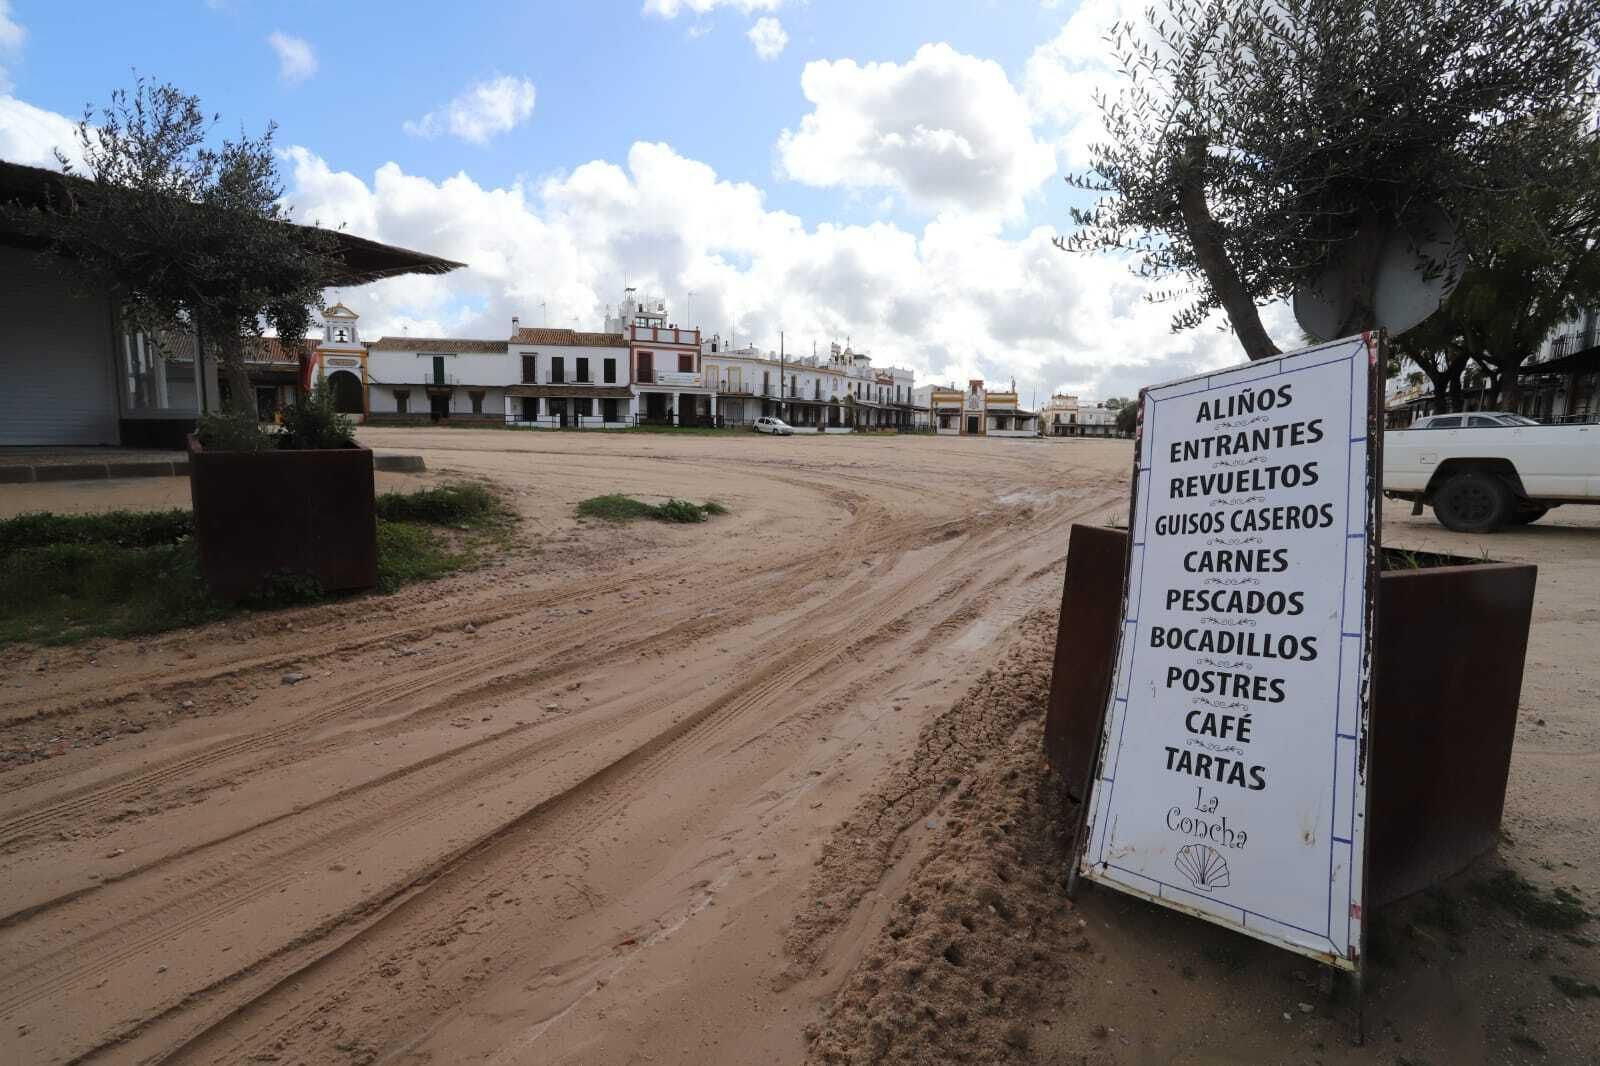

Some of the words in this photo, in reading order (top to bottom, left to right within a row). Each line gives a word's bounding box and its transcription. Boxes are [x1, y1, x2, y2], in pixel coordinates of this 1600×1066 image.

[1196, 384, 1293, 423] ALIÑOS
[1170, 419, 1324, 463] ENTRANTES
[1170, 461, 1319, 499] REVUELTOS
[1155, 511, 1225, 536] GUISOS
[1230, 503, 1334, 533] CASEROS
[1183, 549, 1289, 573] CARNES
[1166, 589, 1305, 616] PESCADOS
[1150, 627, 1318, 661] BOCADILLOS
[1166, 666, 1286, 703] POSTRES
[1185, 710, 1252, 743] CAFÉ
[1165, 746, 1267, 791] TARTAS
[1194, 787, 1219, 815] La
[1166, 806, 1249, 850] Concha
